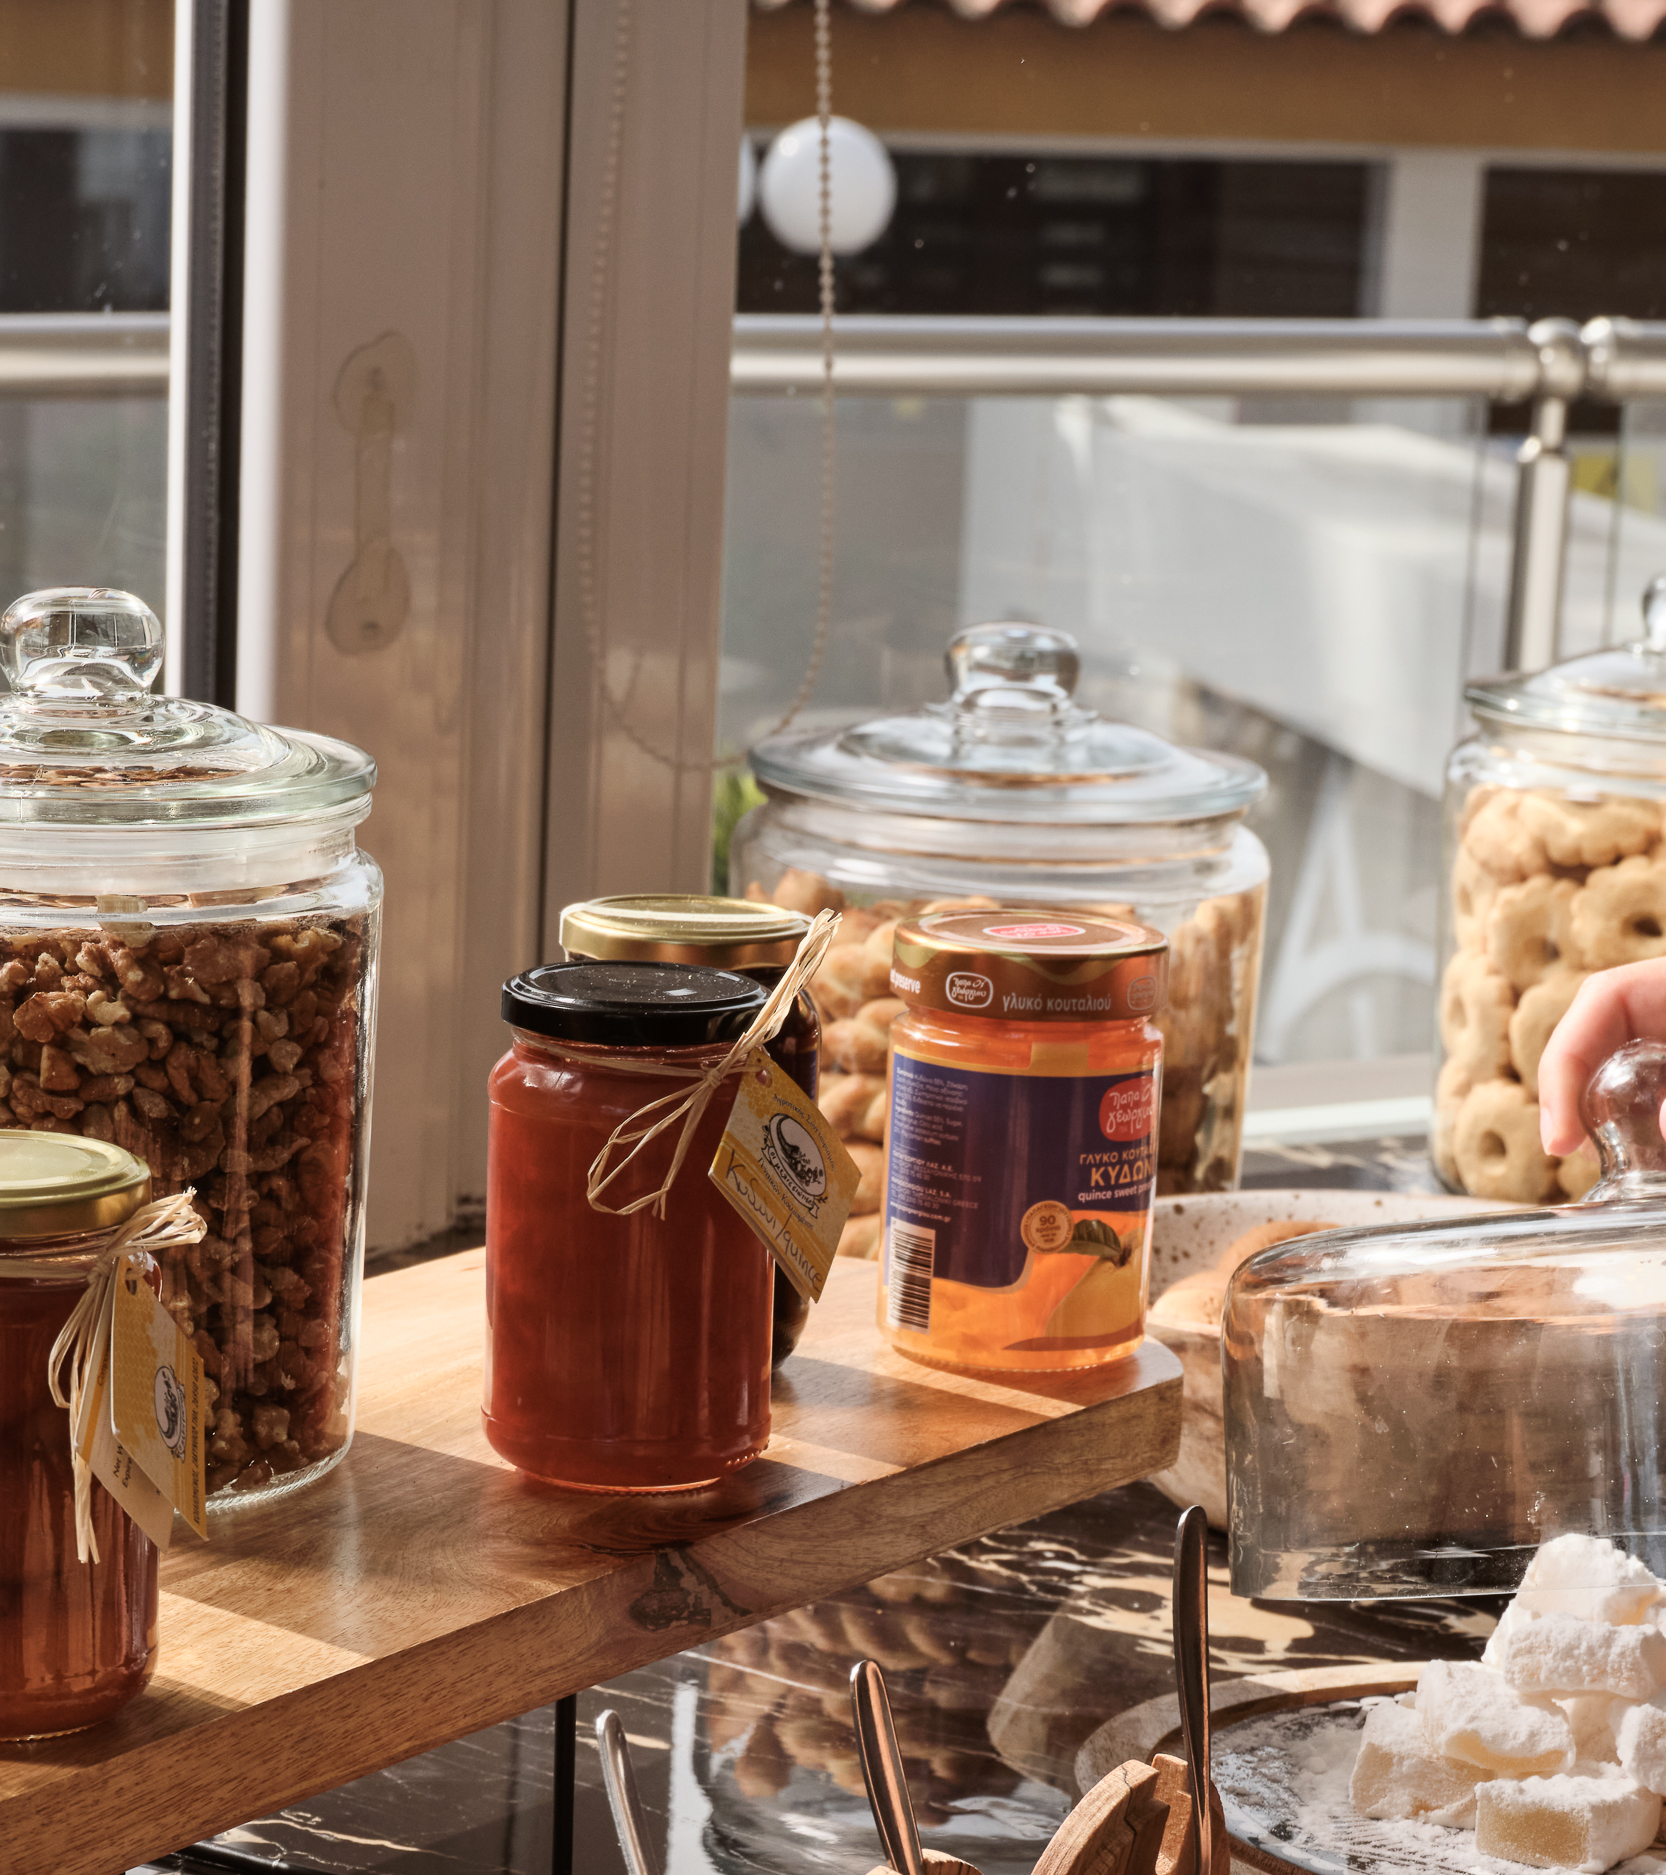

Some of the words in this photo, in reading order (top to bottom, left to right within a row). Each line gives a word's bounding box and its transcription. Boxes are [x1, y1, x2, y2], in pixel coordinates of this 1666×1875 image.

[1002, 993, 1043, 1012] γλυκό
[1046, 993, 1112, 1012] κουταλιού
[1080, 1152, 1119, 1165] ΓΛΥΚΟ
[1078, 1189, 1112, 1203] quince
[1114, 1184, 1137, 1199] sweet
[1039, 1214, 1056, 1226] 90
[112, 1458, 123, 1478] Net
